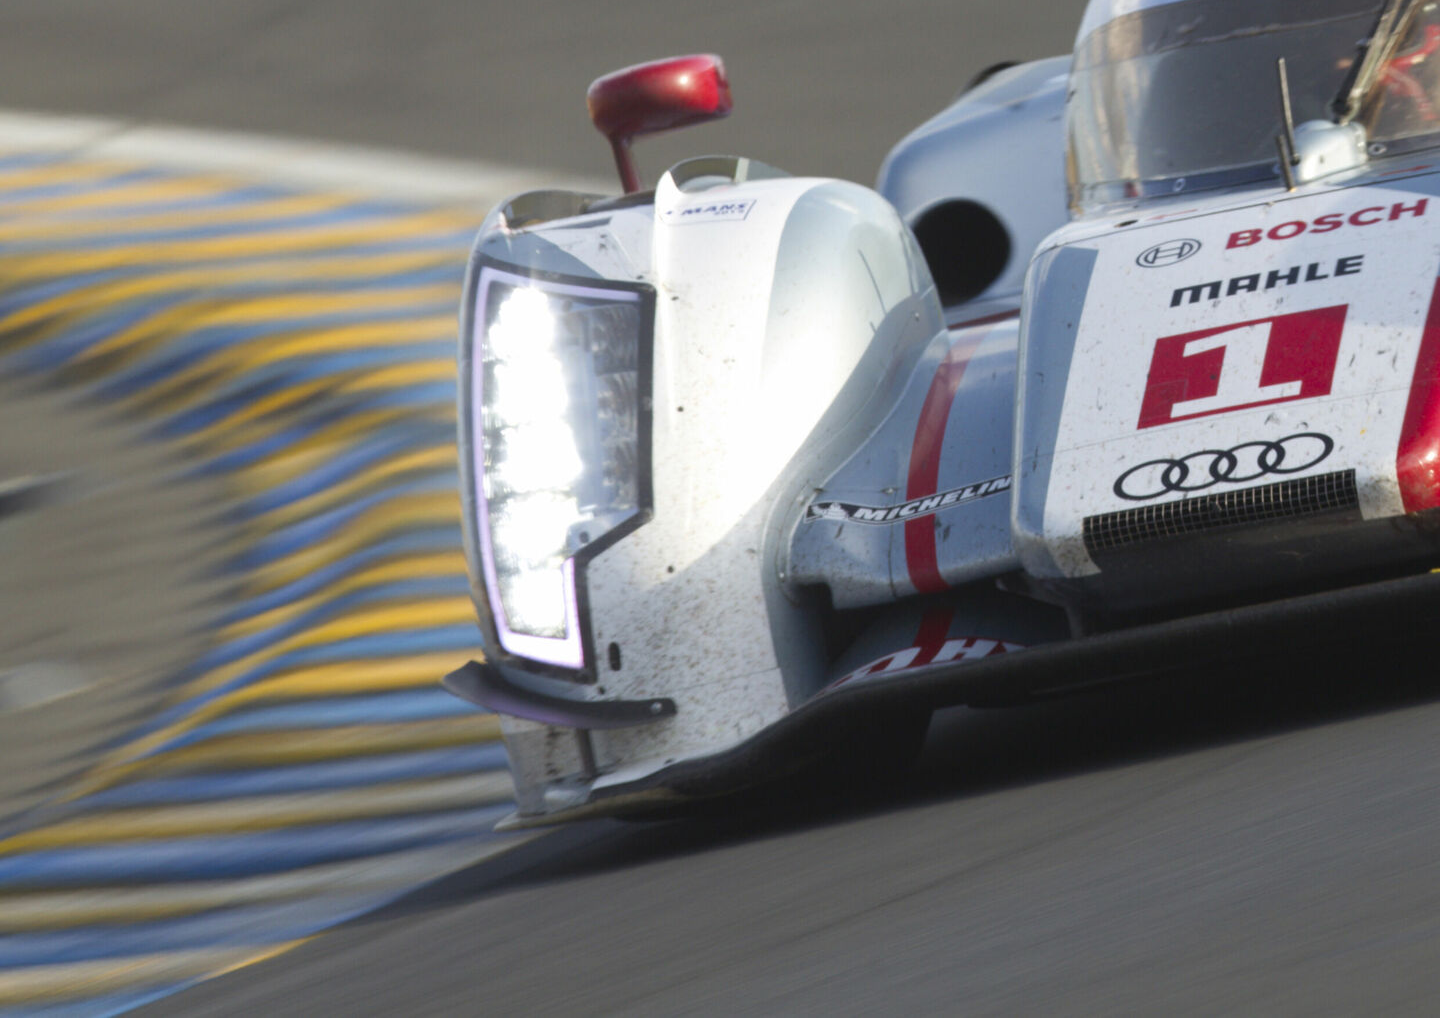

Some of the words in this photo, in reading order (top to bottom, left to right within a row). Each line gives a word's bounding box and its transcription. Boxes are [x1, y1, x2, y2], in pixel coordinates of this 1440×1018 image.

[1226, 199, 1428, 250] BOSCH
[1170, 255, 1365, 307] MAHLE
[1169, 320, 1303, 420] 1
[853, 476, 1013, 522] MICHELIN
